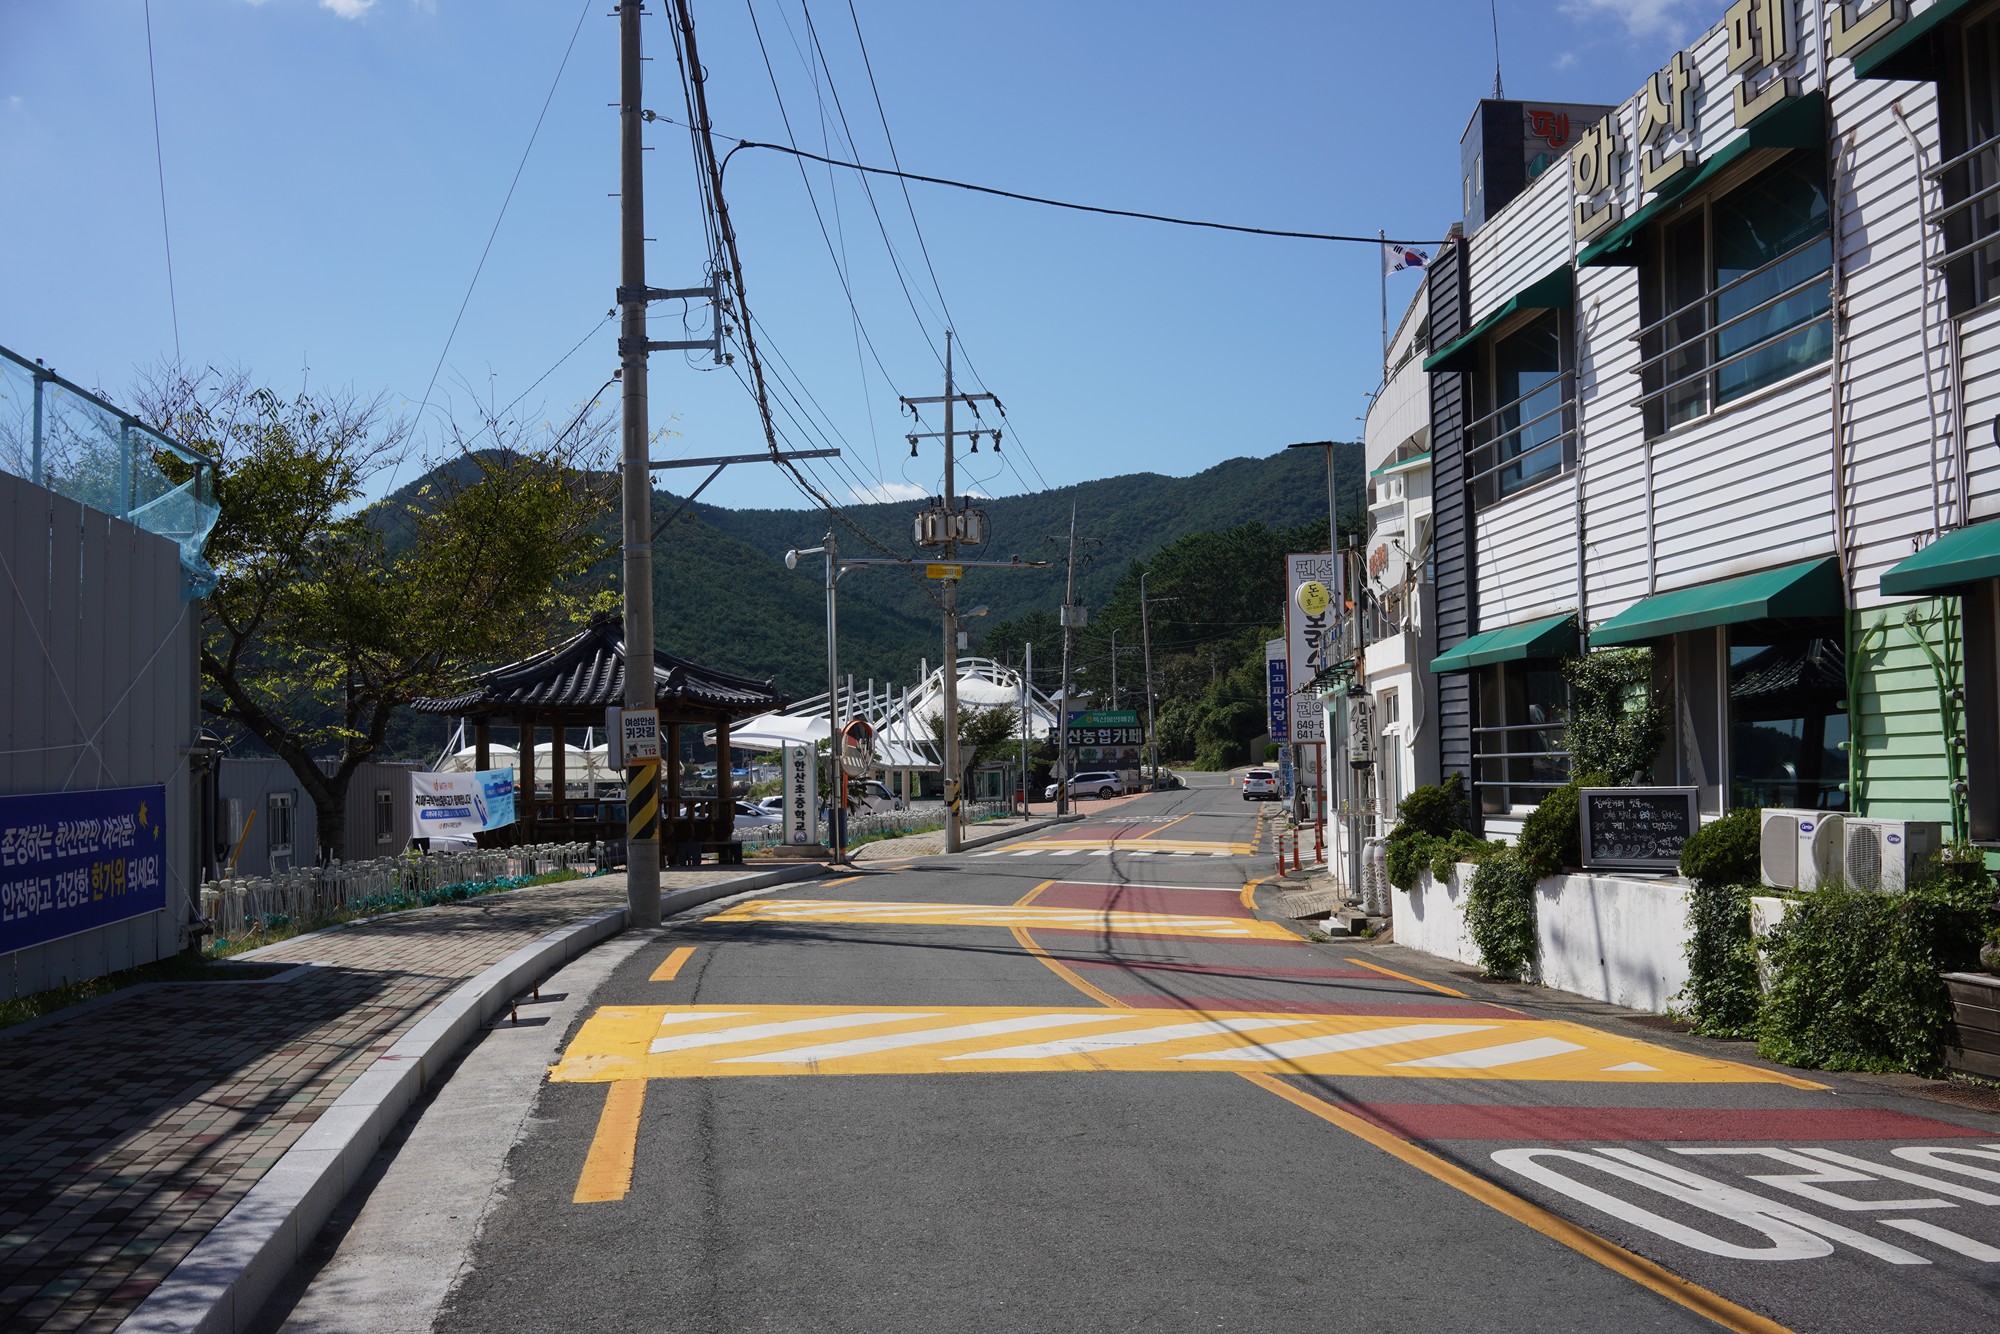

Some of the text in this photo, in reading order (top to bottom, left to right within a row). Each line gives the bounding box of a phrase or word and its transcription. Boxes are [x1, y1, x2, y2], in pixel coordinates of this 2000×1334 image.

[1573, 0, 1906, 242] 한산펜
[1271, 662, 1286, 721] 가고파식당
[625, 716, 656, 727] 여성안심
[625, 726, 656, 739] 귀갓길
[644, 748, 657, 756] 112
[1, 813, 136, 867] 존경하는 한산면민 여러분!
[1, 854, 159, 922] 안전하고 건강한 한가위 되세요!
